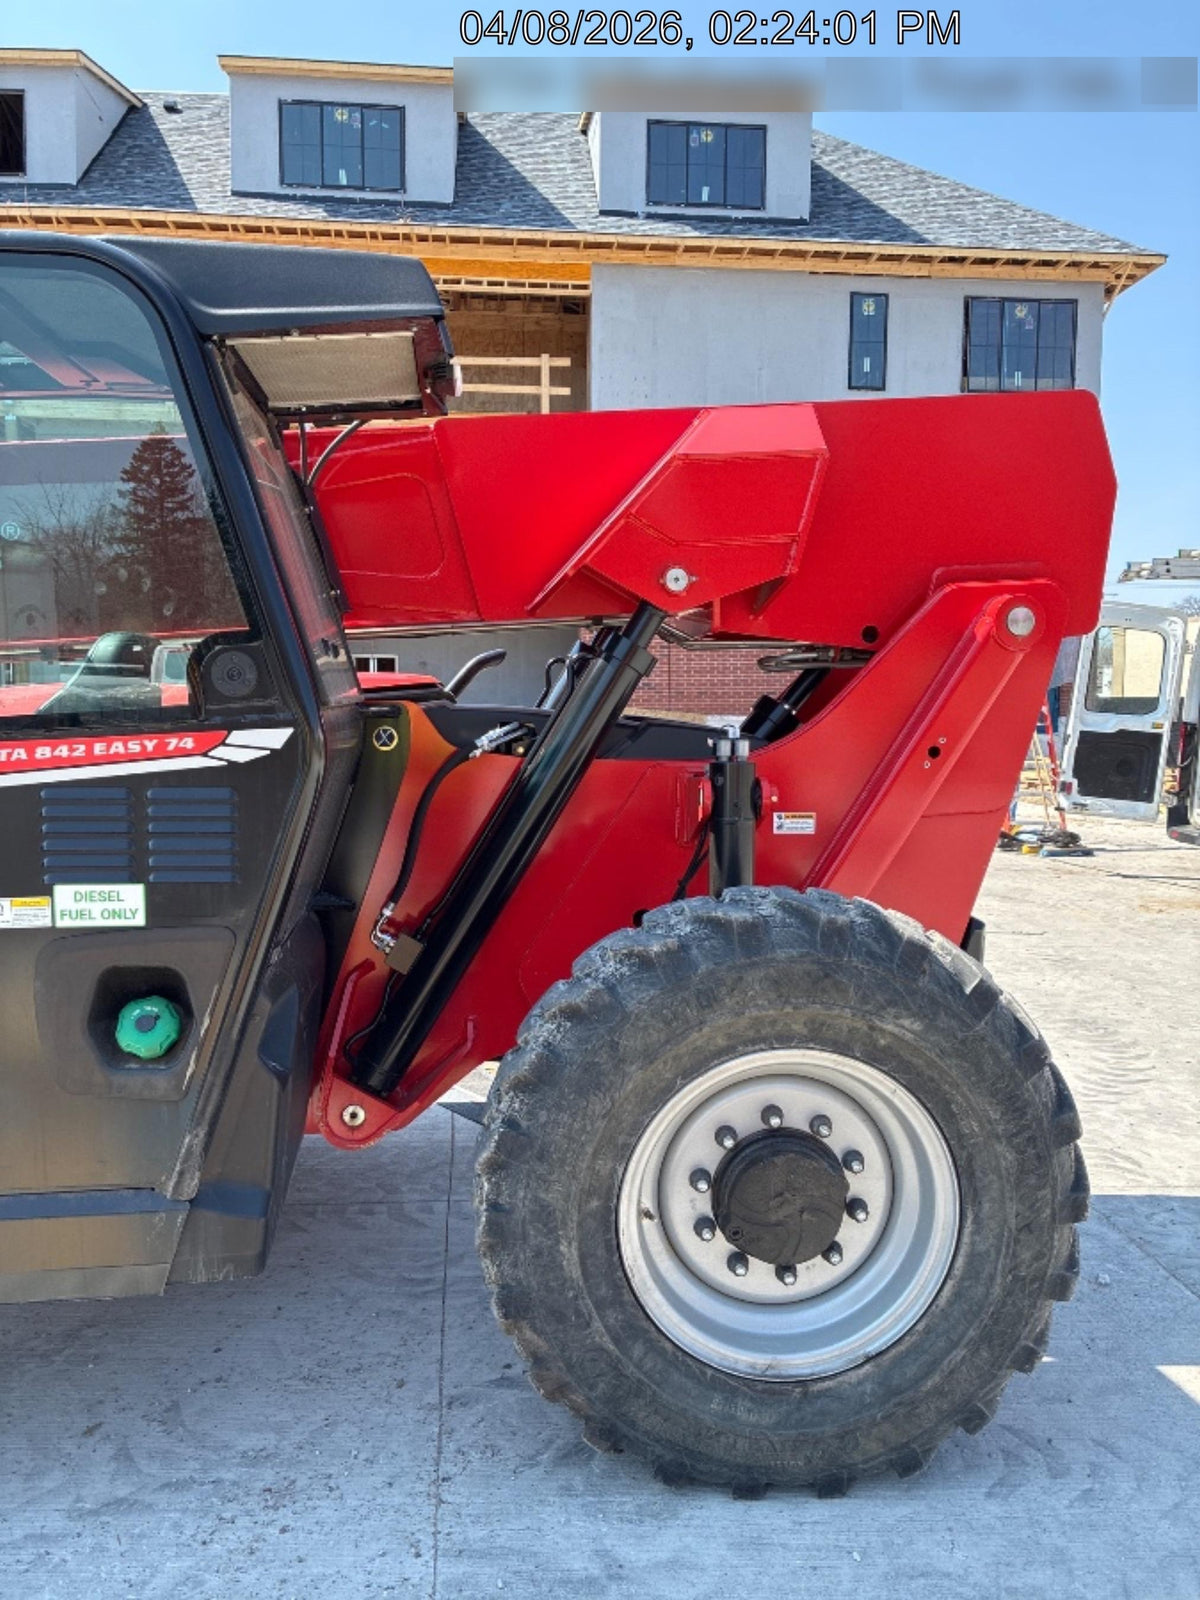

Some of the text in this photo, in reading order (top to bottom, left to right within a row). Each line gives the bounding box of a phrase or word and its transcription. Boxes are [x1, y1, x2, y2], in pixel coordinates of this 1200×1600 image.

[34, 744, 86, 759] 842
[94, 739, 158, 756] EASY
[164, 737, 195, 751] 74
[73, 890, 125, 902] DIESEL
[60, 908, 96, 921] FUEL
[101, 908, 139, 920] ONLY
